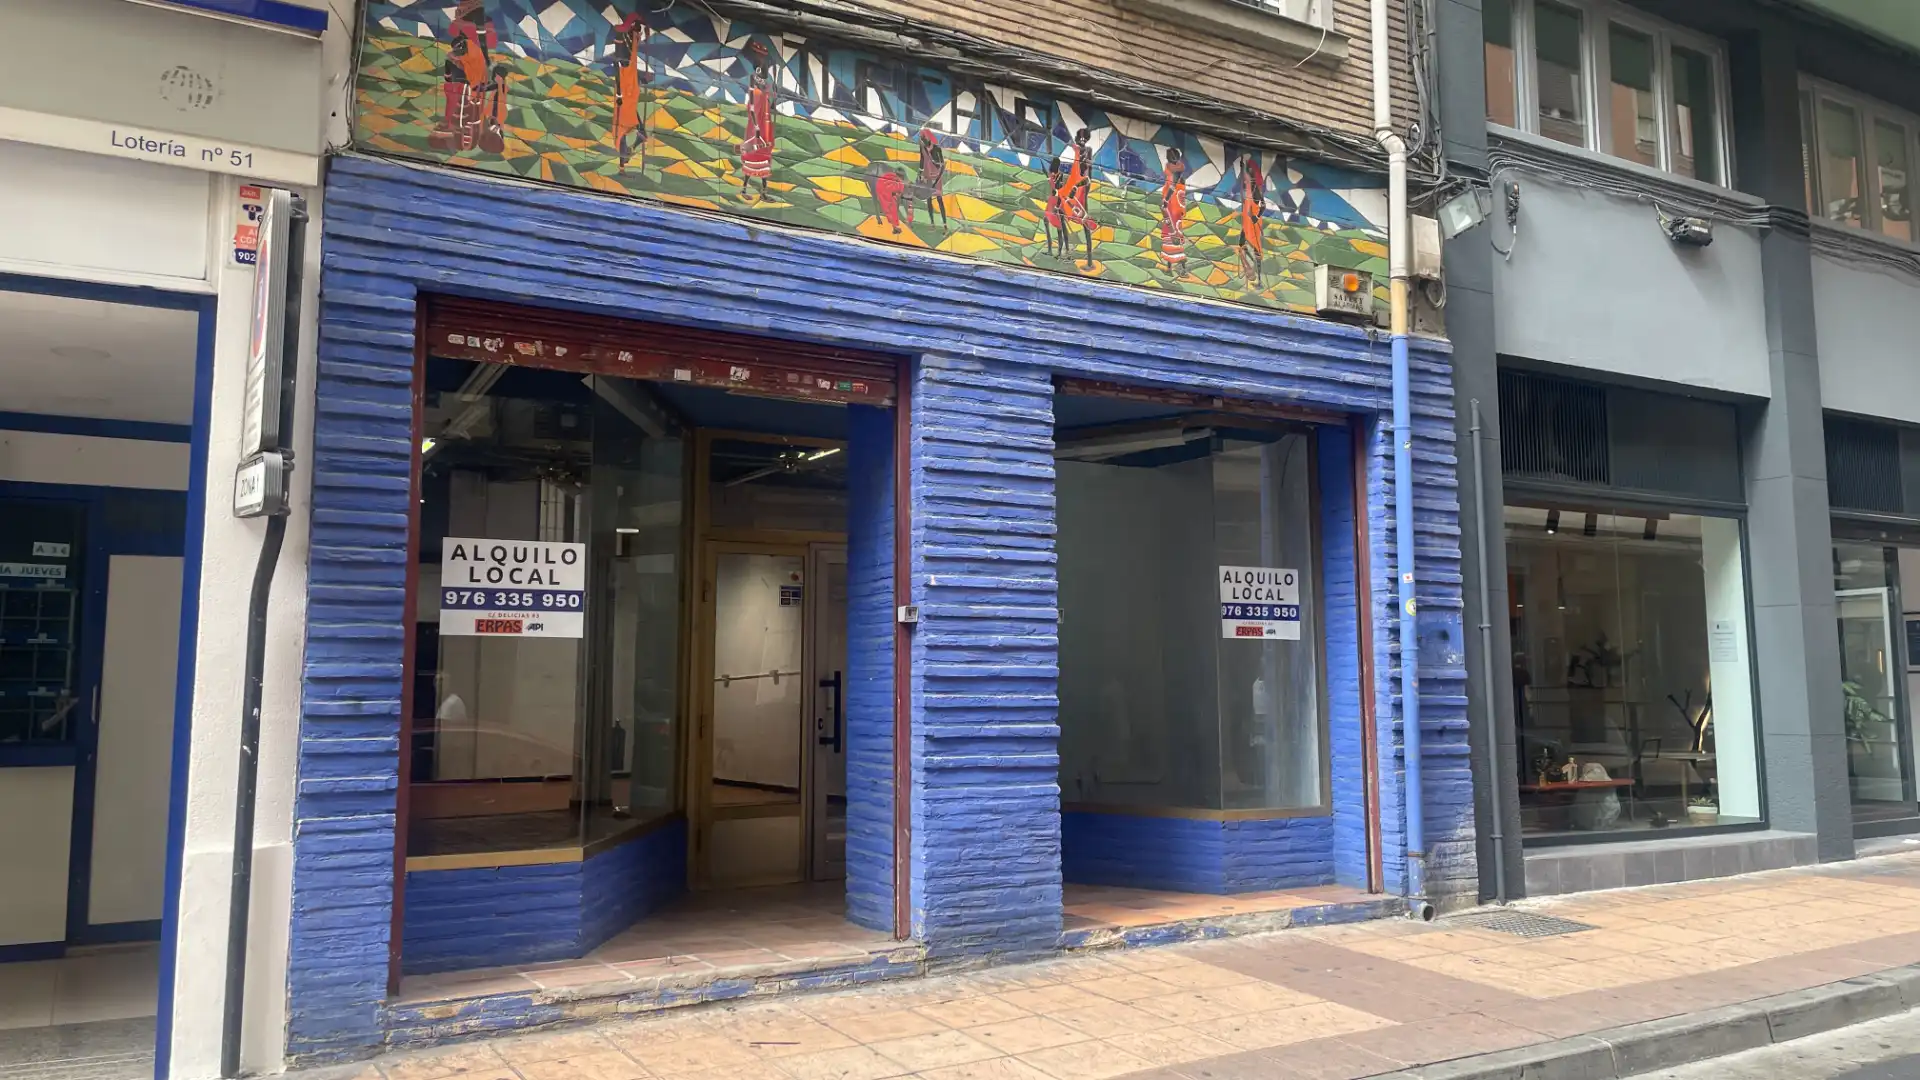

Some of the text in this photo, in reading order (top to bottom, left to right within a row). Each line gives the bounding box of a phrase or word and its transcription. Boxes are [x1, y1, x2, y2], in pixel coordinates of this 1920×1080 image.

[111, 130, 253, 168] Lotería nº 51
[238, 251, 256, 262] 902
[240, 475, 256, 497] ZONA
[450, 544, 577, 566] ALQUILO
[19, 565, 62, 576] JUEVES
[469, 566, 560, 586] LOCAL
[1223, 570, 1294, 587] ALQUILO
[445, 591, 580, 608] 976 335 950
[1232, 587, 1284, 601] LOCAL
[1246, 606, 1269, 617] 335
[1273, 607, 1297, 618] 950
[476, 619, 522, 633] ERPAS
